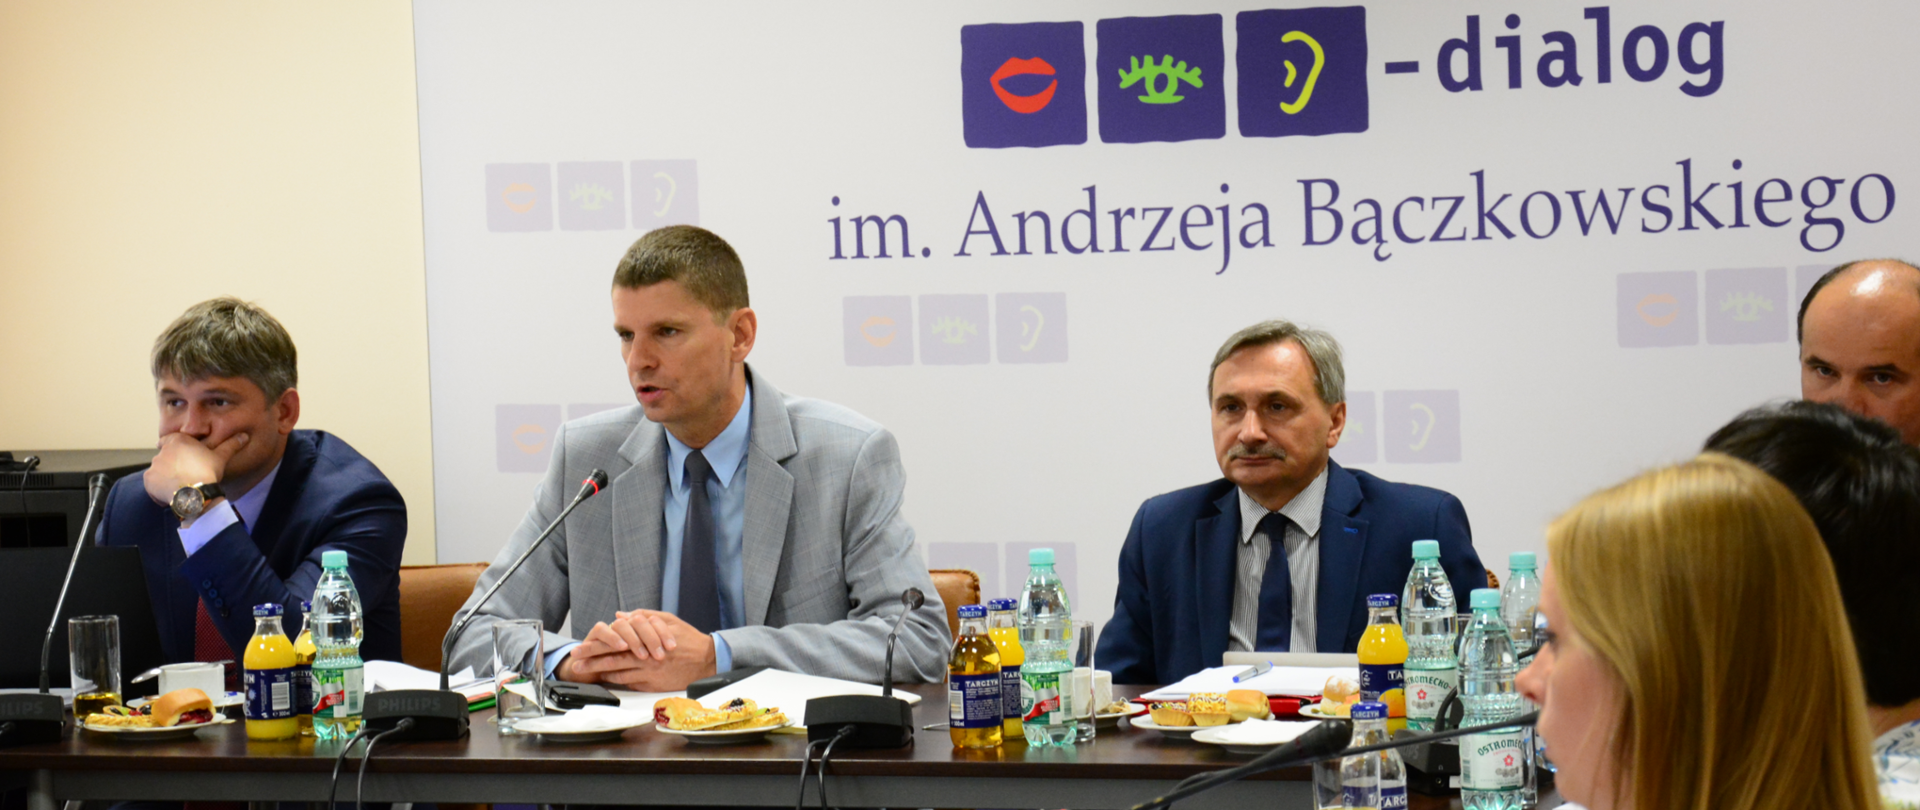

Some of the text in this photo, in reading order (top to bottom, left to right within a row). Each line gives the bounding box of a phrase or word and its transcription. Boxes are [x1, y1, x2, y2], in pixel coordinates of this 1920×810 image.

[1385, 6, 1725, 98] -dialog
[829, 158, 1896, 271] im. Andrzeja Bączkowskiego
[965, 679, 999, 688] TARCZYN
[0, 701, 44, 717] ILIPS
[378, 697, 441, 712] PHILIPS
[1352, 710, 1380, 718] TARCZYN
[1477, 738, 1523, 756] OSTROMEC
